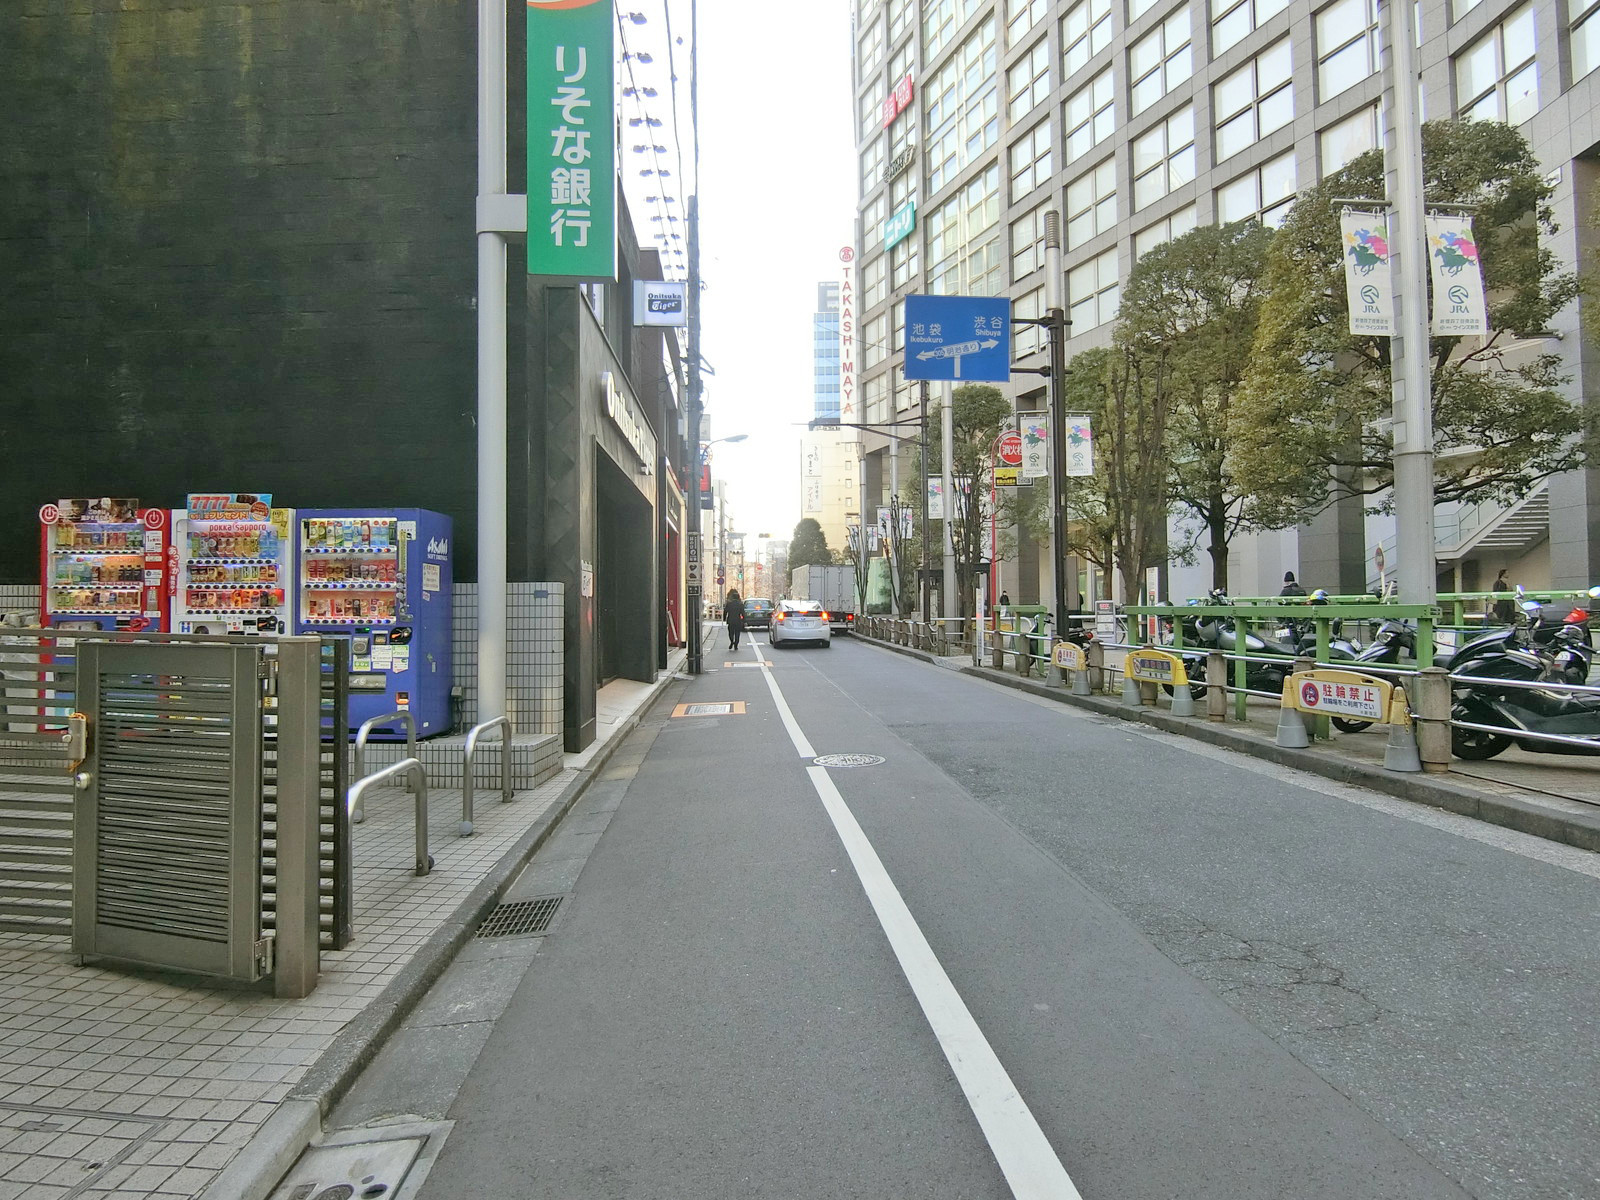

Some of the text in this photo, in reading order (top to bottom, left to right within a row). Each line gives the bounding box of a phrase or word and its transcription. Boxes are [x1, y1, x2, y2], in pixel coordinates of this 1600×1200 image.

[550, 45, 592, 248] りそな銀行
[886, 207, 911, 245] ニトリ
[651, 300, 678, 311] Tiger
[1362, 305, 1381, 314] JRA
[1449, 305, 1470, 314] JRA
[974, 316, 1003, 329] 渋谷
[912, 323, 942, 336] 池袋
[975, 328, 1002, 337] Shibuya
[842, 267, 853, 415] TAKASHIMAYA
[910, 335, 944, 343] Ikebukuro
[190, 496, 231, 510] 7777
[209, 523, 267, 532] pokka sapporo
[168, 546, 180, 575] あったか
[1322, 684, 1375, 702] 駐輪禁止
